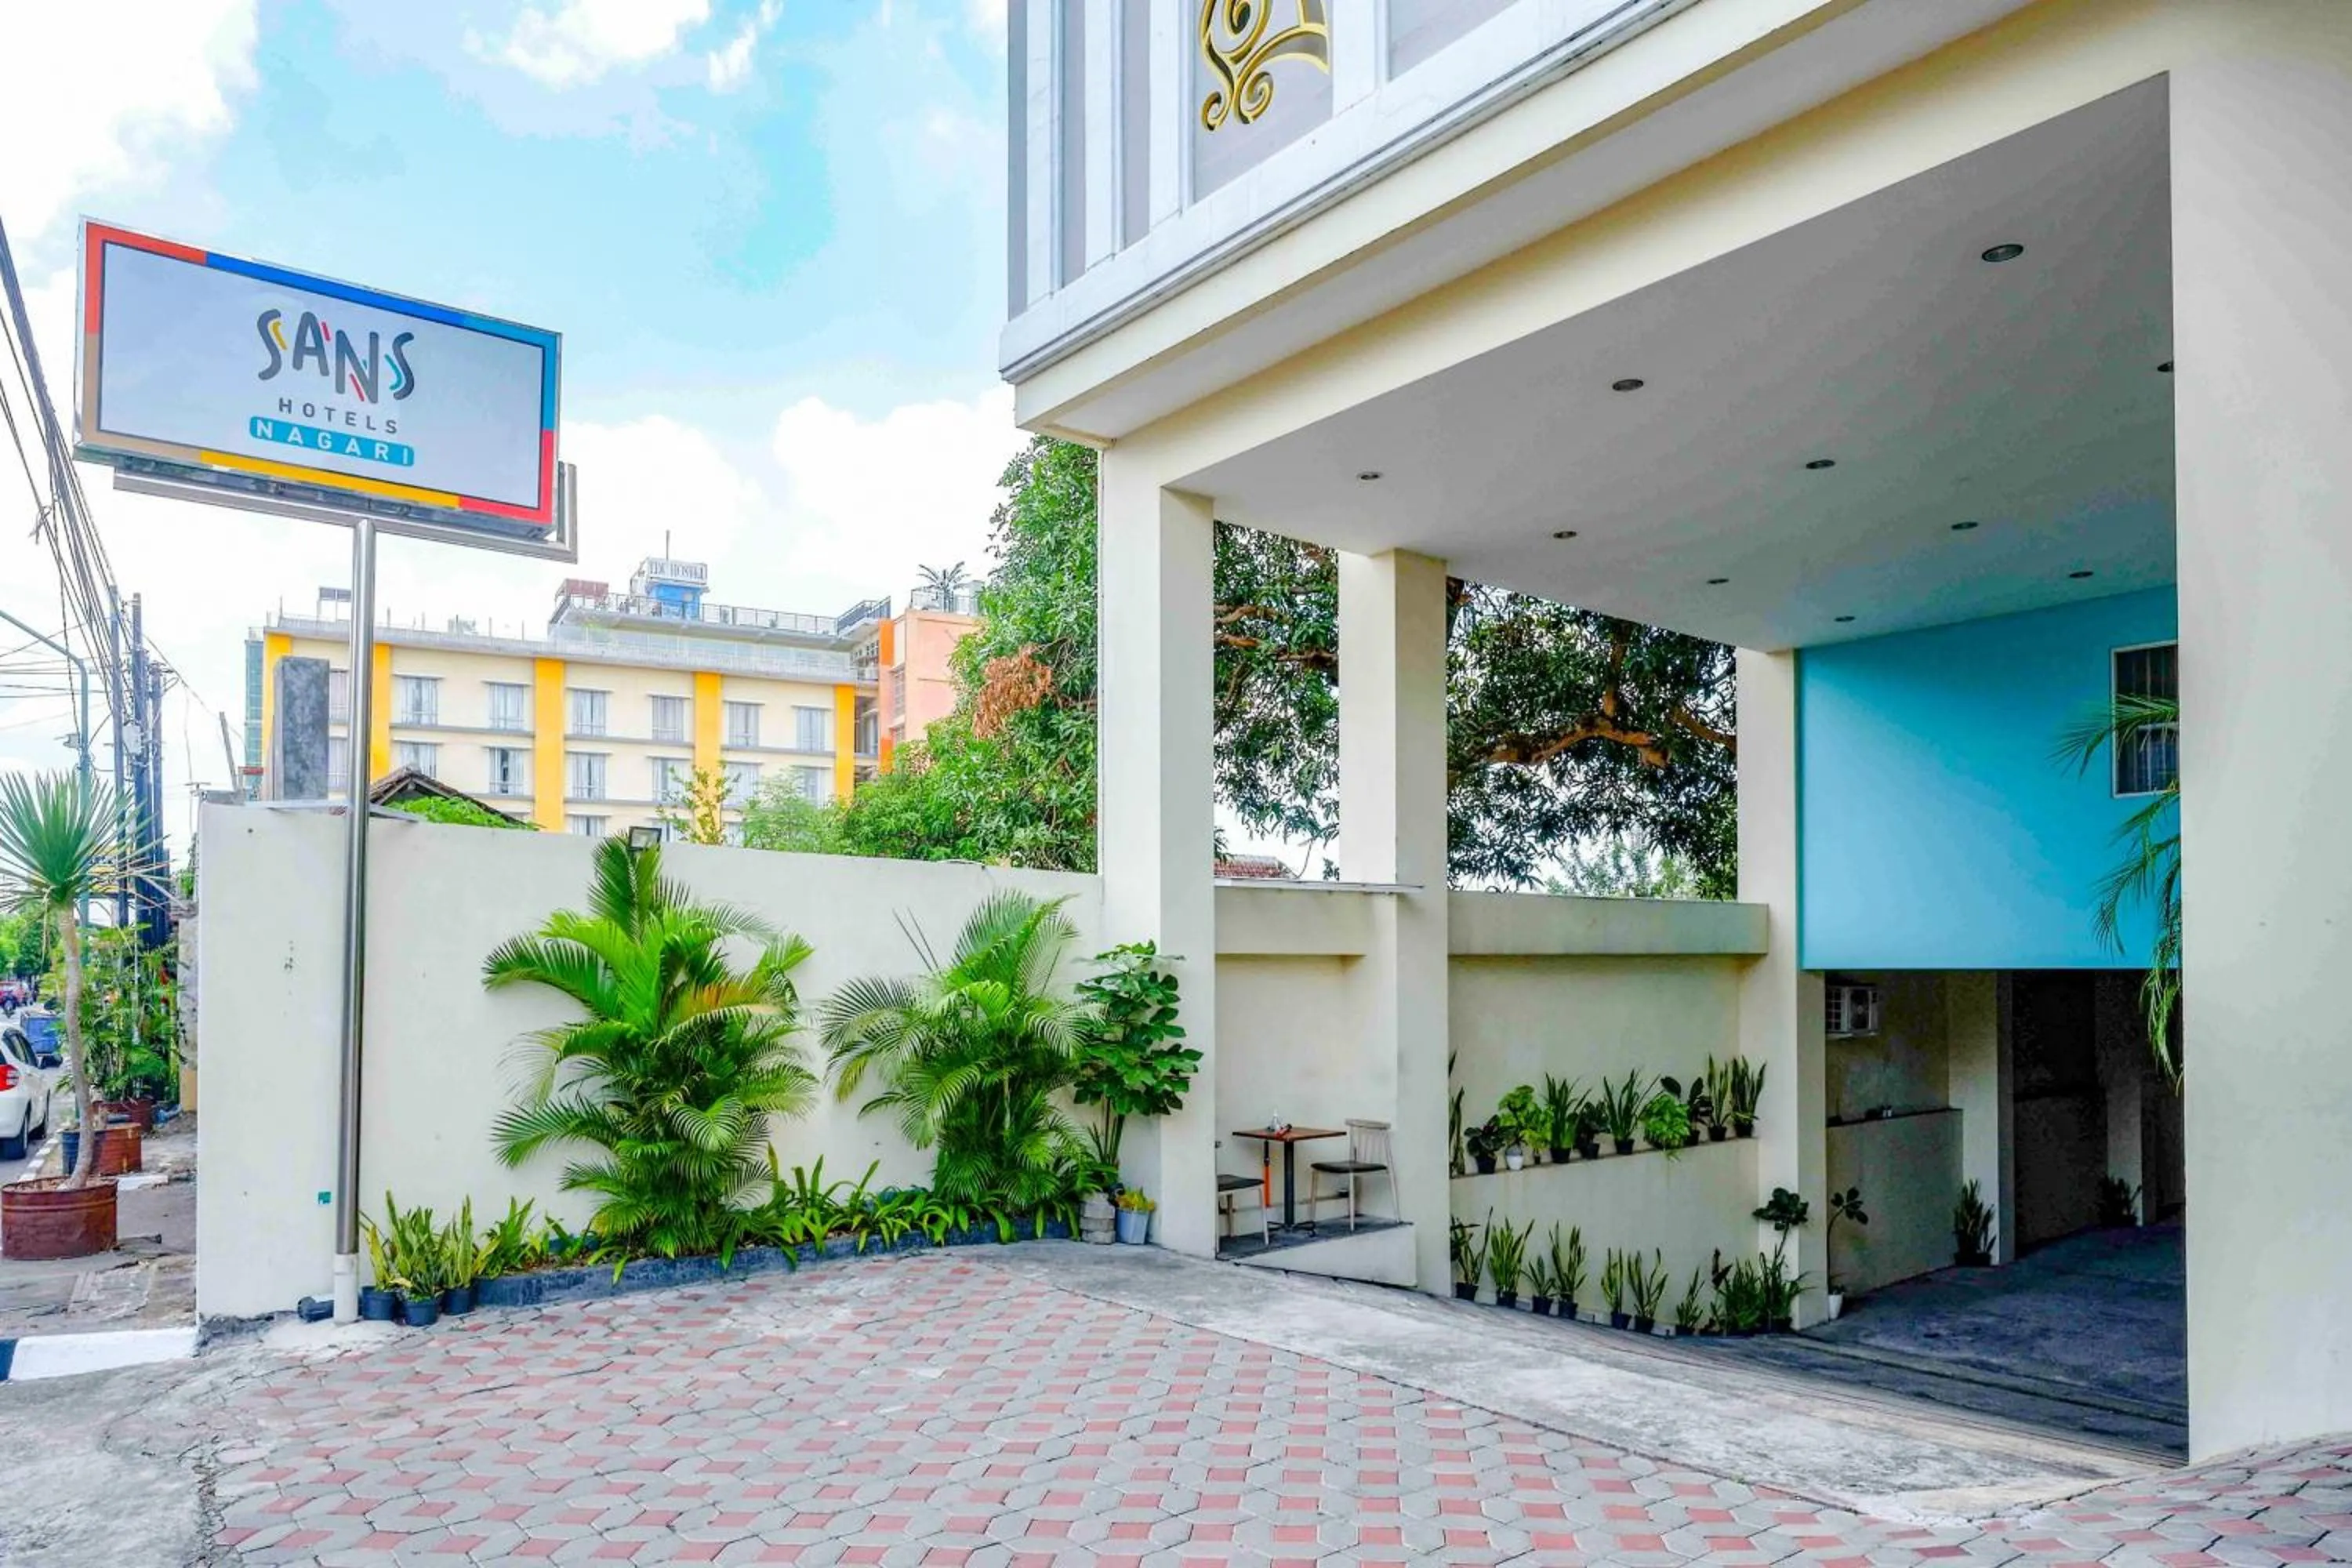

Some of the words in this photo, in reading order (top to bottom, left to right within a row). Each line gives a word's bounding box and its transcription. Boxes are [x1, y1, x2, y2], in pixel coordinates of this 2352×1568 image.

[257, 309, 415, 405] SANS
[278, 397, 398, 434] HOTELS
[256, 419, 409, 465] NAGARI
